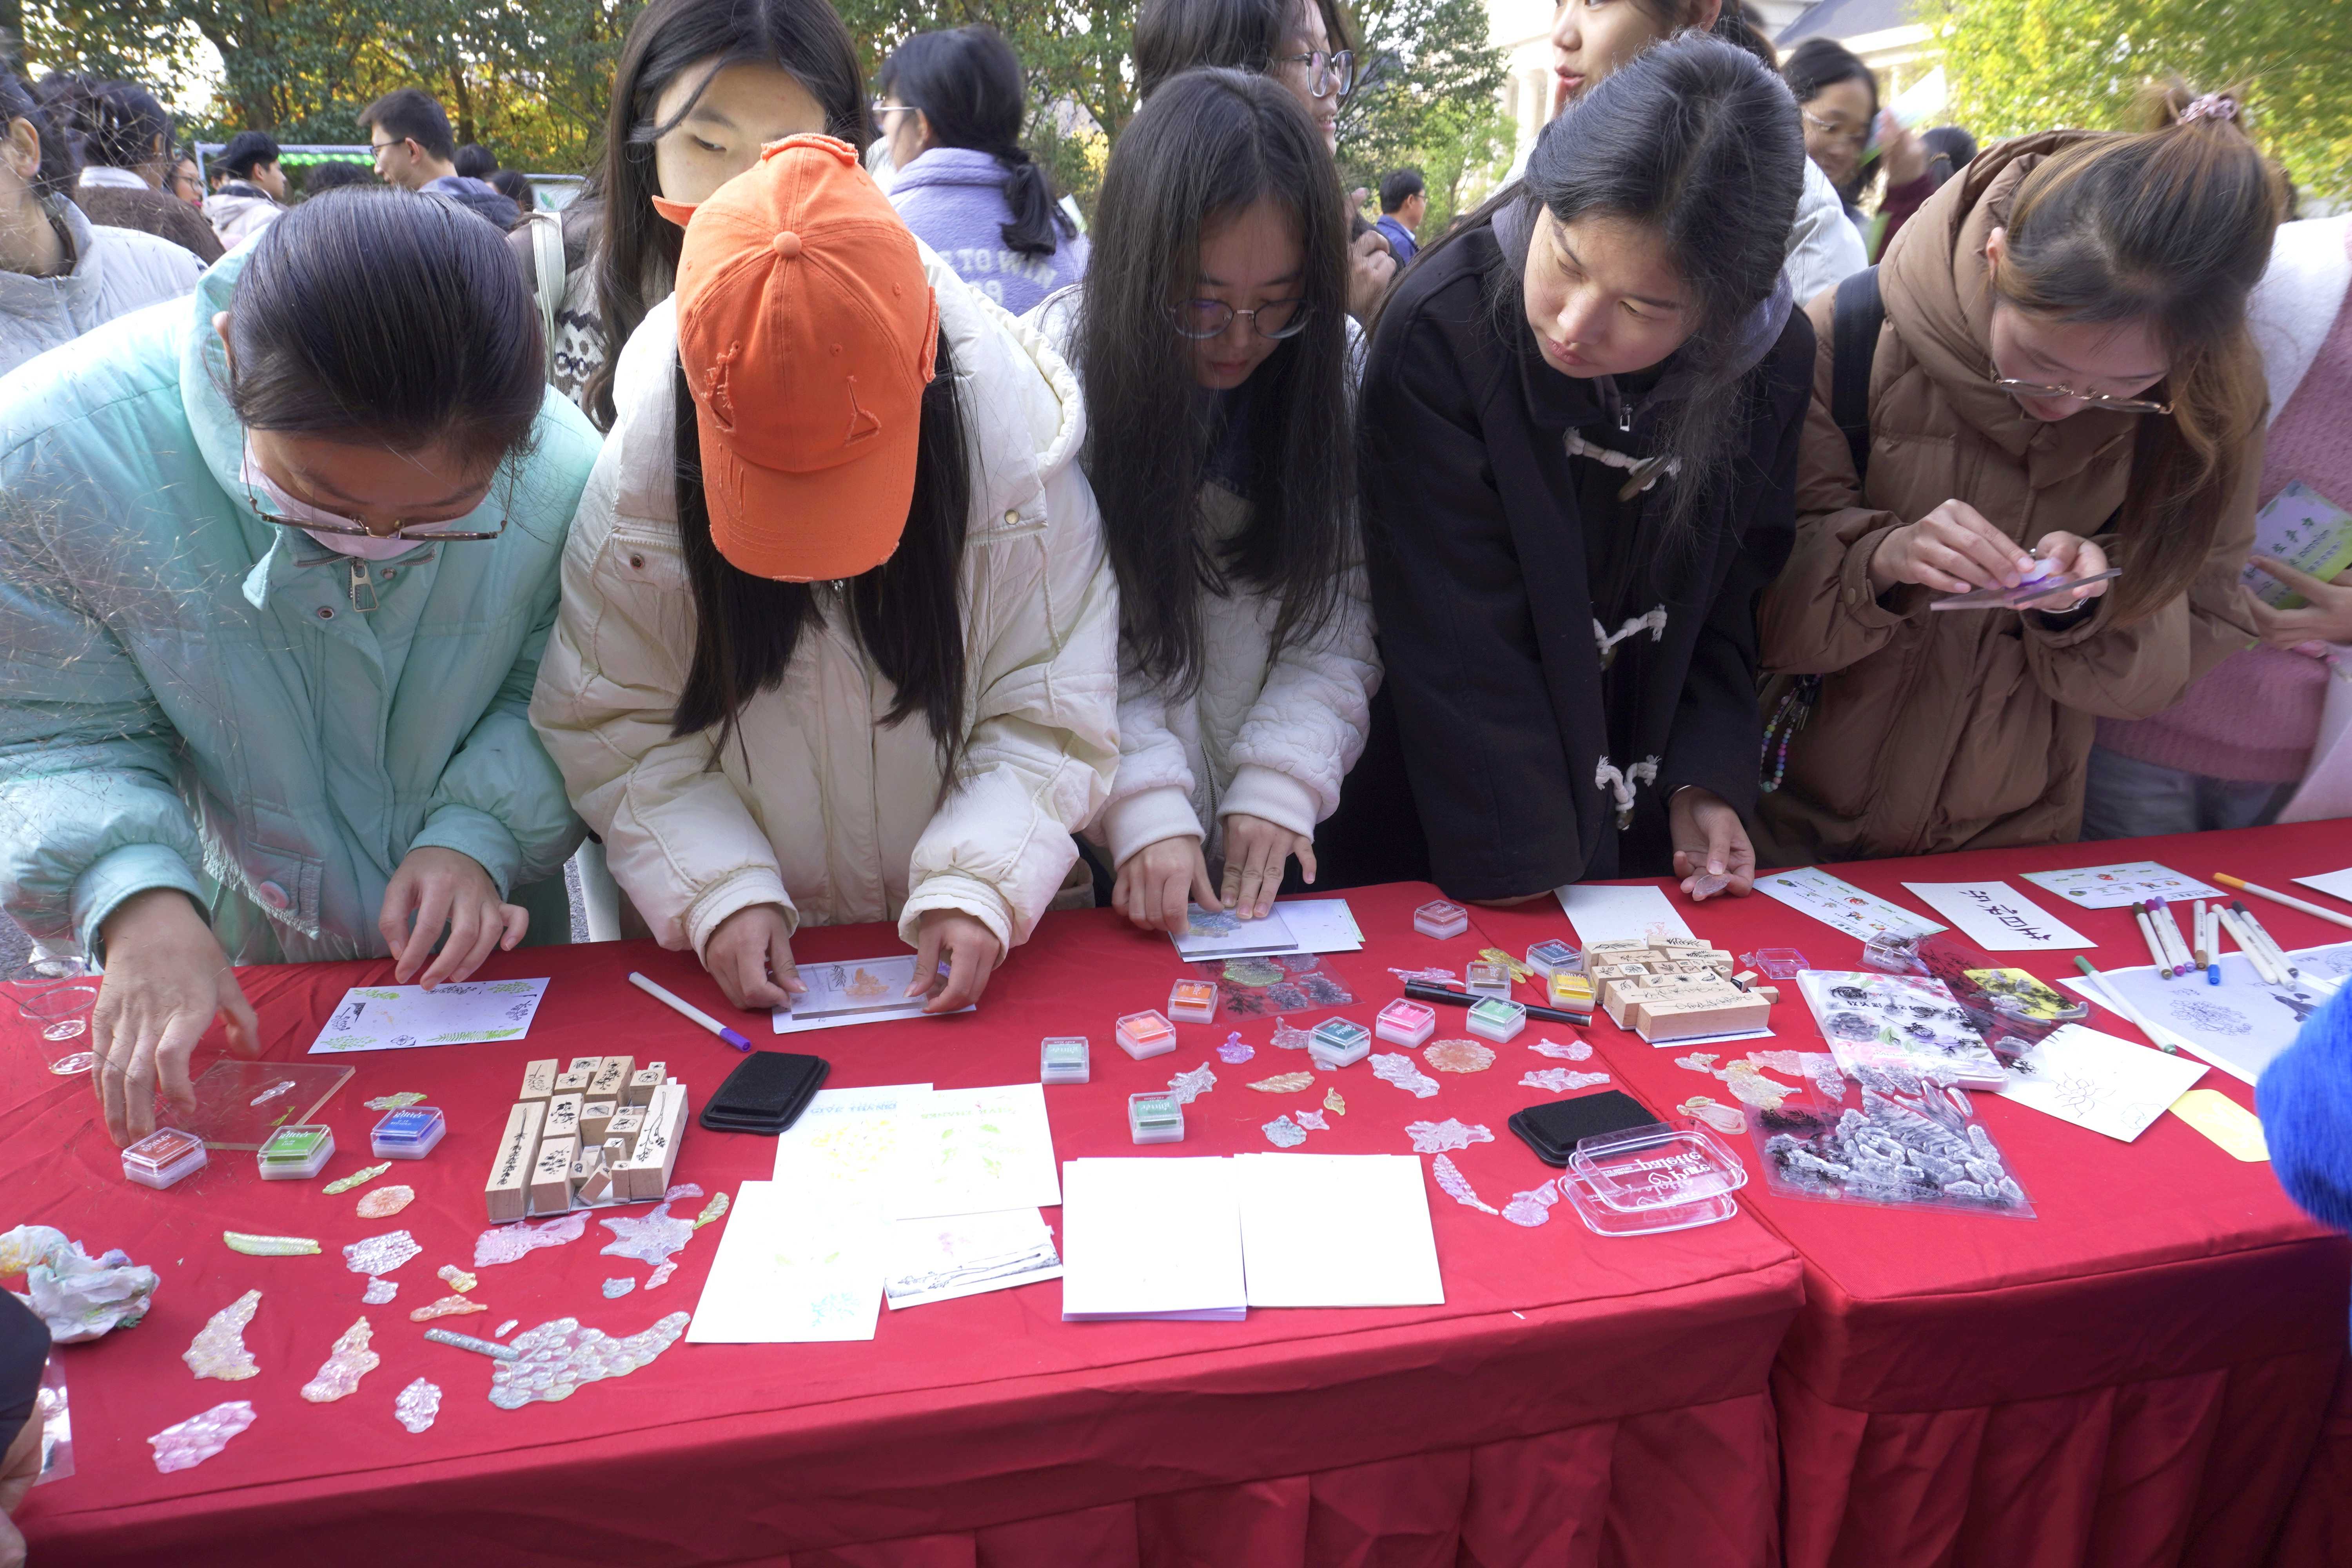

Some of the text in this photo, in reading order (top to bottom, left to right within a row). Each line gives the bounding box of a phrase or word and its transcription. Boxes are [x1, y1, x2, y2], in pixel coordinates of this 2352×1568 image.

[955, 248, 991, 272] TO
[998, 249, 1058, 289] WIN
[1958, 890, 2052, 941] 生日快乐
[392, 1109, 426, 1118] glitter
[142, 1133, 171, 1152] glitter
[278, 1130, 313, 1140] glitter
